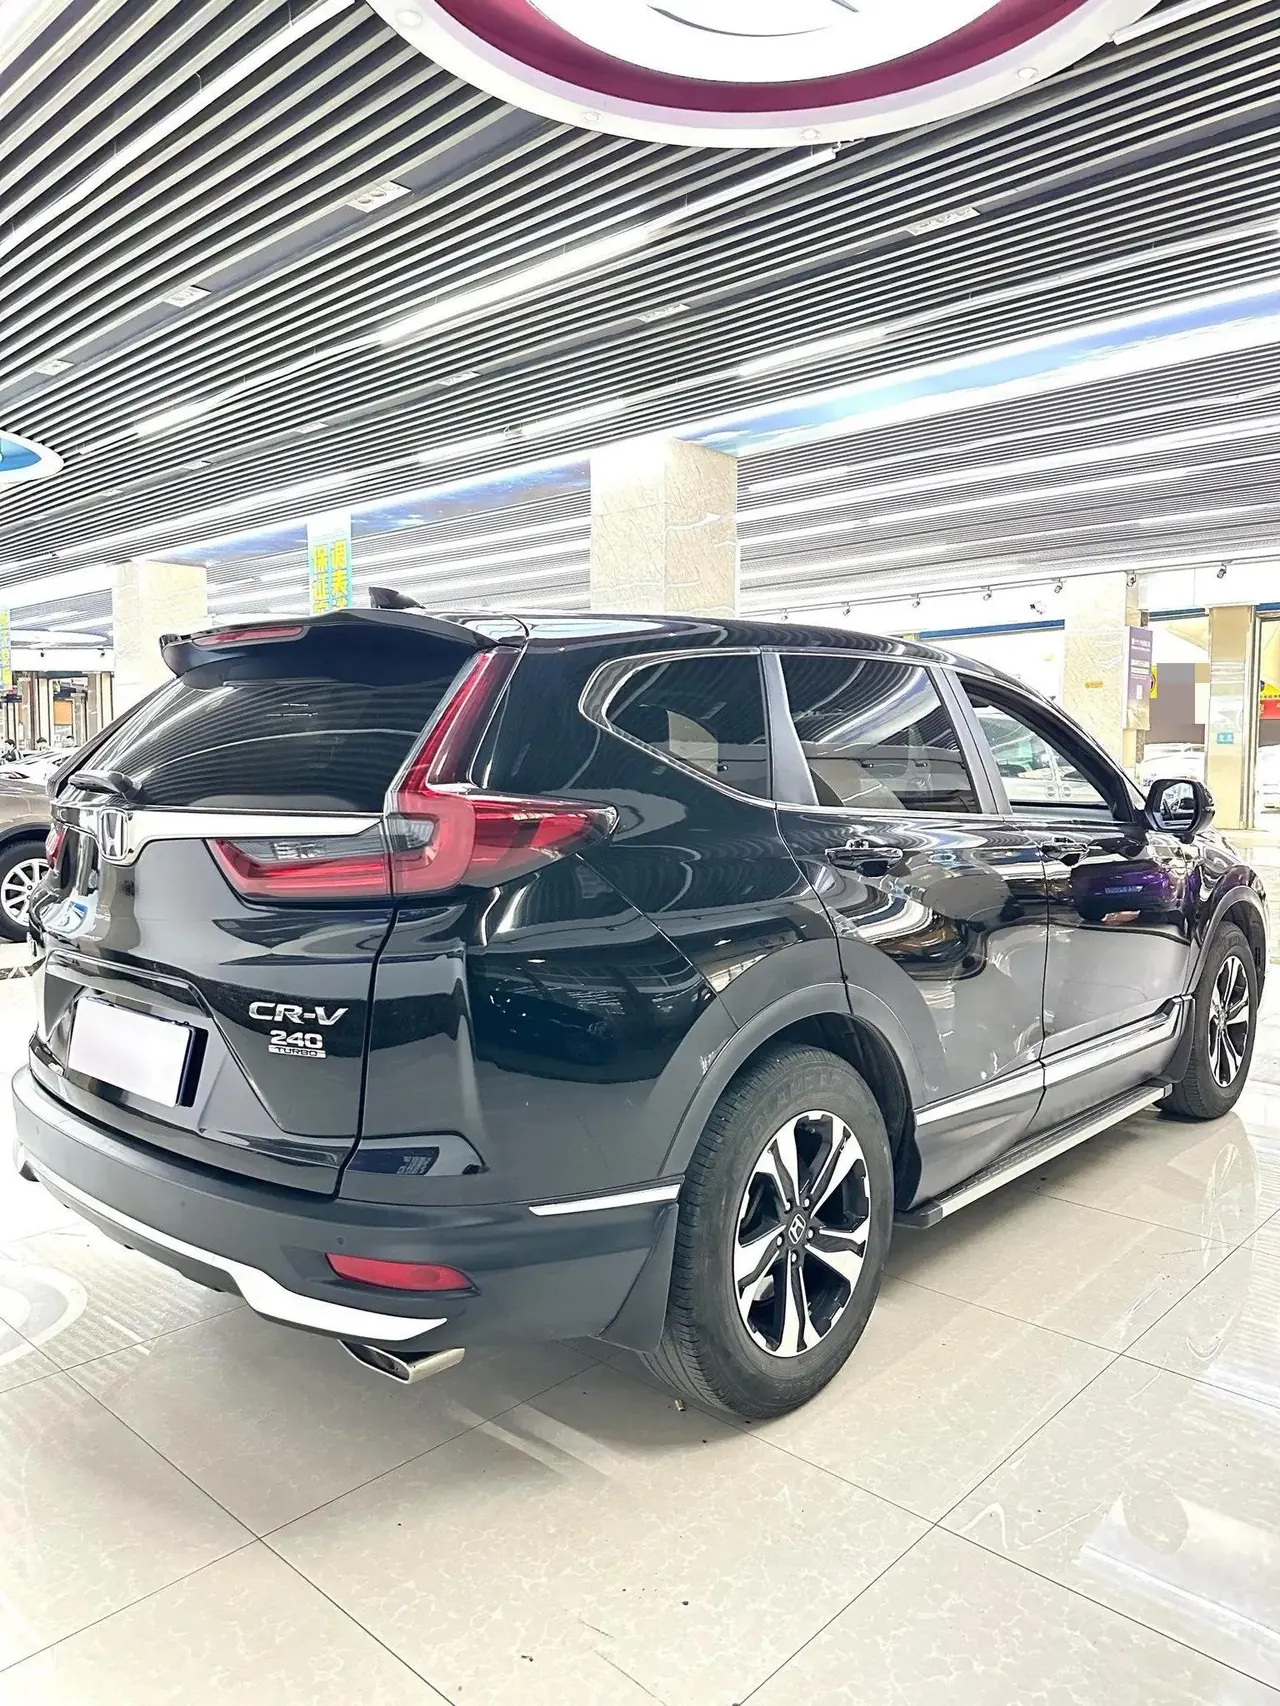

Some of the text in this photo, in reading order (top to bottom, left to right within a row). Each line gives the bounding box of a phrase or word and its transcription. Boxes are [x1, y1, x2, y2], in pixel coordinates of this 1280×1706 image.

[248, 1001, 349, 1026] CR-V
[269, 1029, 324, 1049] 240
[275, 1046, 319, 1057] TURBO
